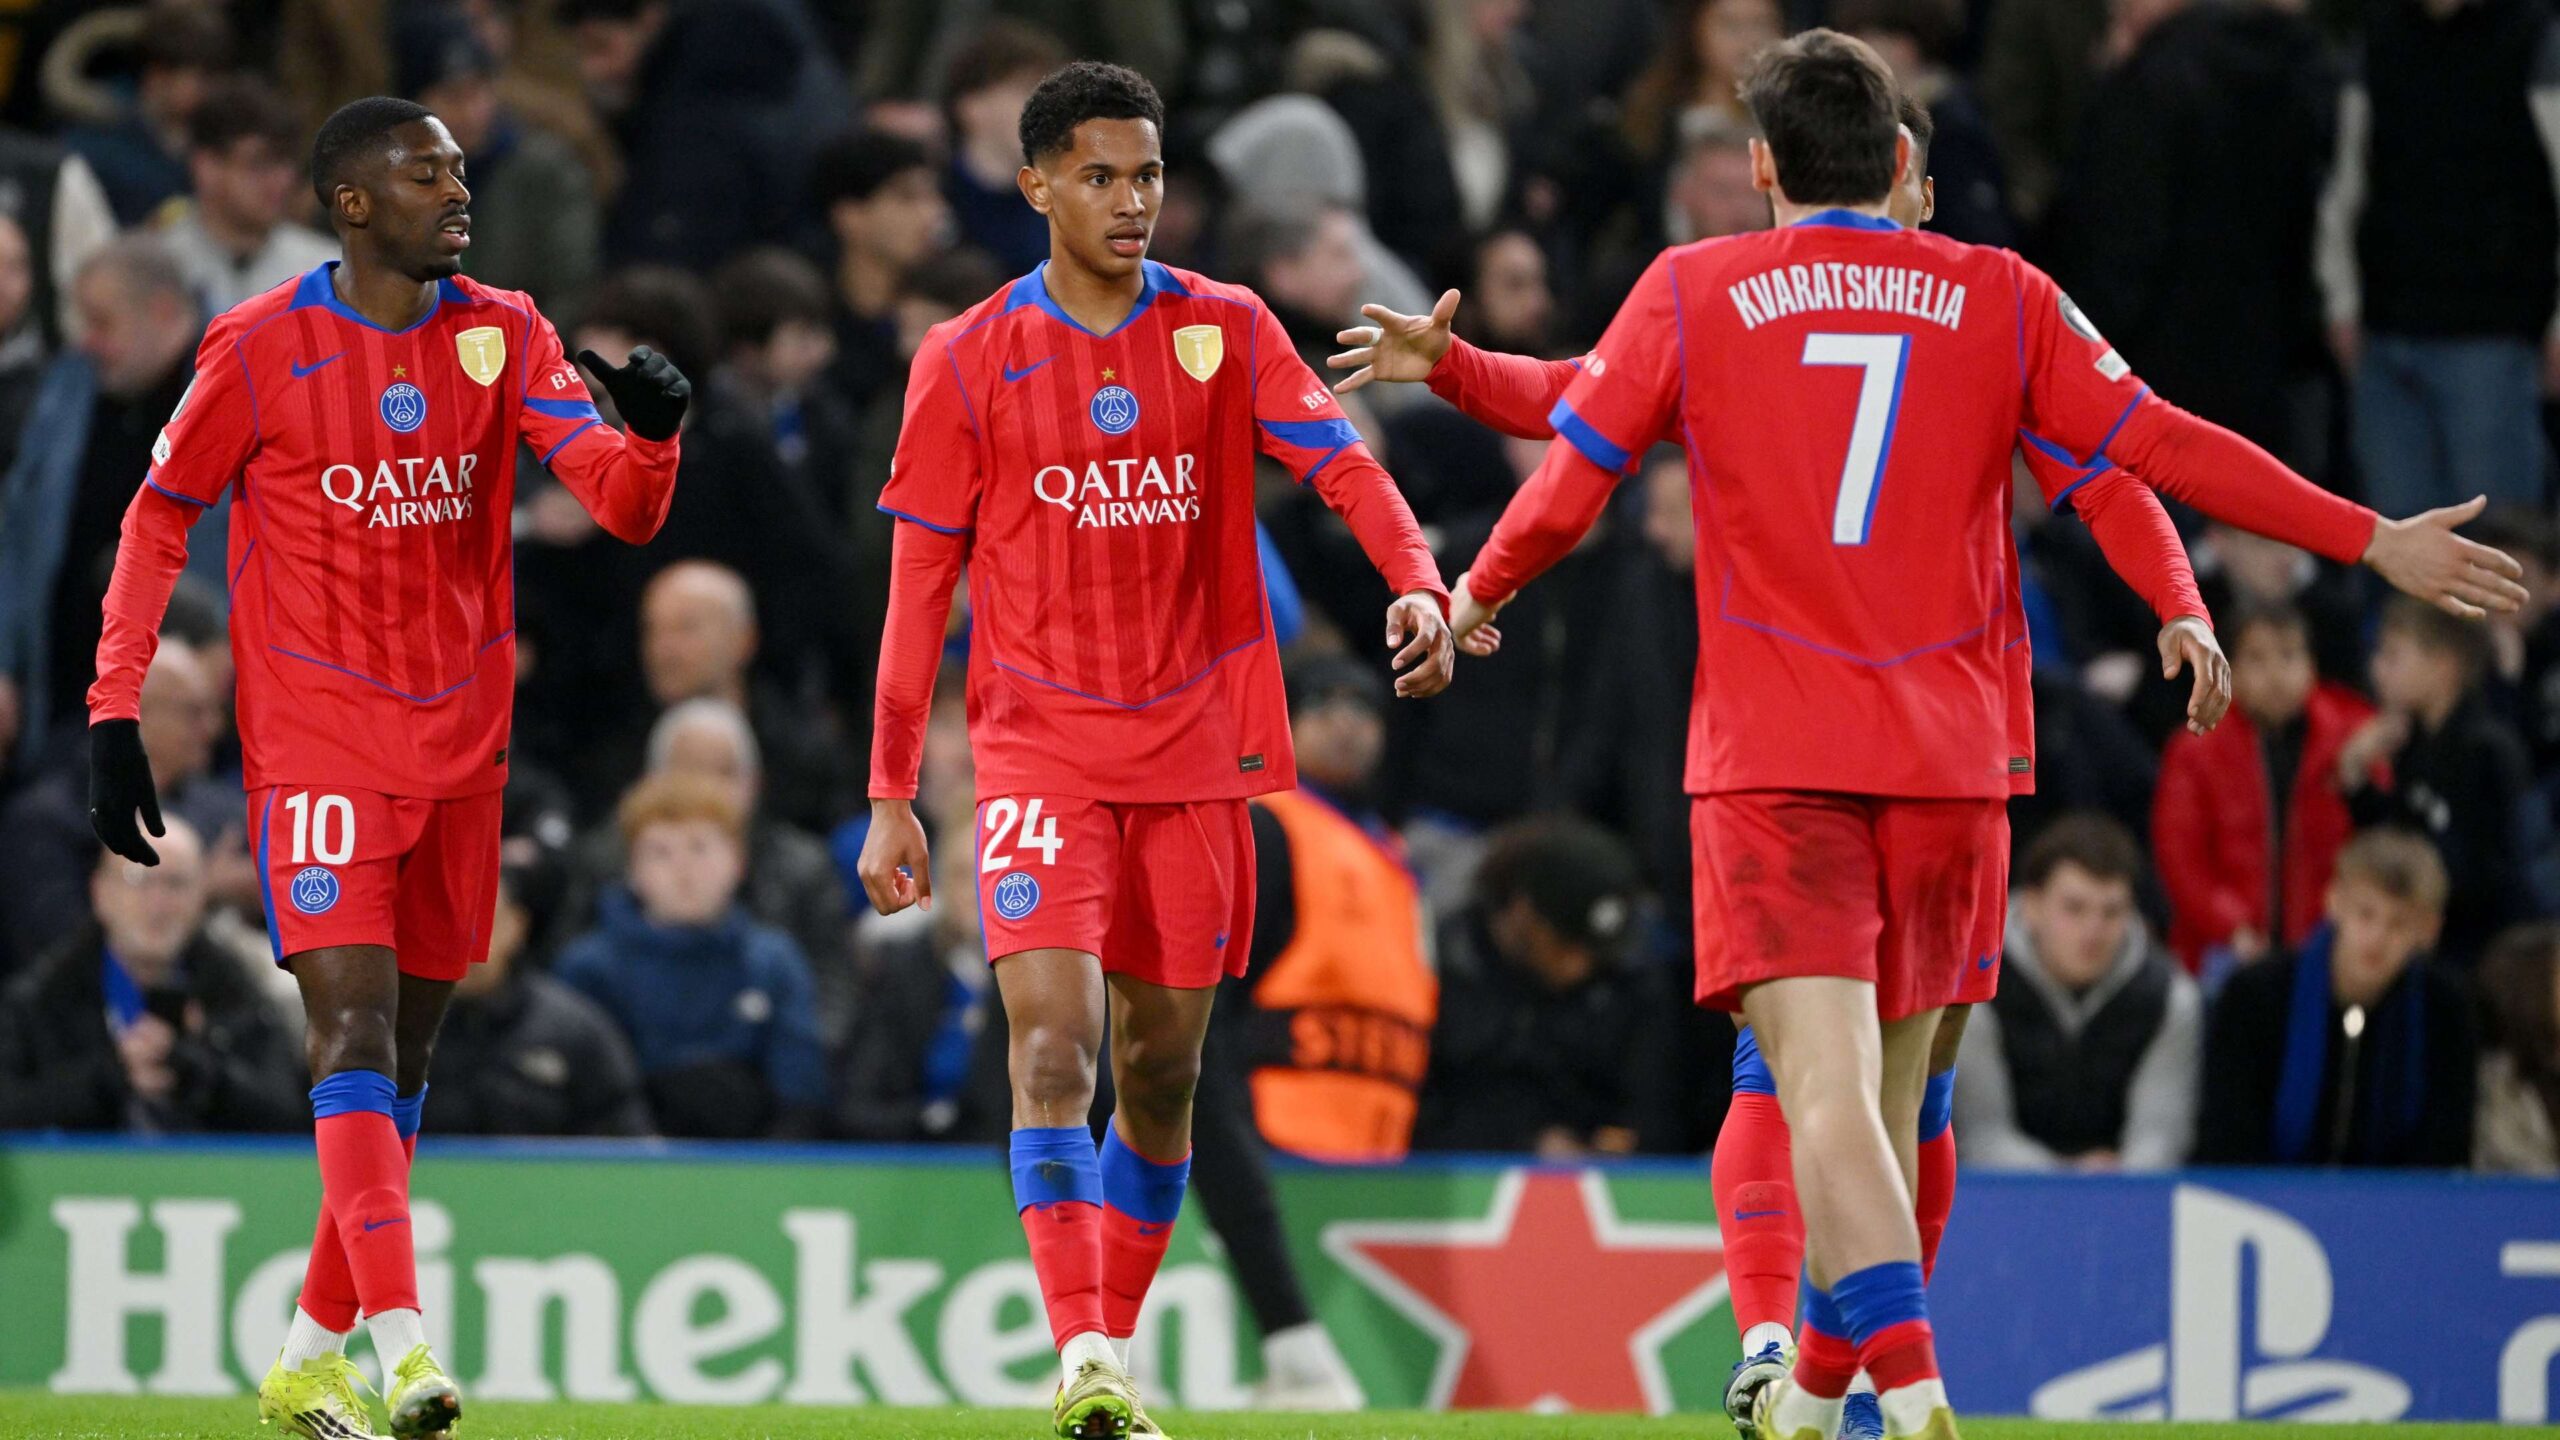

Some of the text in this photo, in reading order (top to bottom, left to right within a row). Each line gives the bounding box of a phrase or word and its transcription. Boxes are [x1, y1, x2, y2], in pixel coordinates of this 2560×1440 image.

[1729, 262, 1966, 331] KVARATSKHELIA
[387, 386, 416, 399] PARIS
[1097, 388, 1128, 401] PARIS
[1802, 333, 1911, 545] 7
[321, 453, 477, 512] QATAR
[1033, 453, 1197, 512] QATAR
[368, 493, 473, 528] AIRWAYS
[1077, 495, 1200, 529] AIRWAYS
[286, 791, 355, 865] 10
[982, 797, 1064, 873] 24
[298, 869, 329, 882] PARIS
[1001, 875, 1030, 888] PARIS
